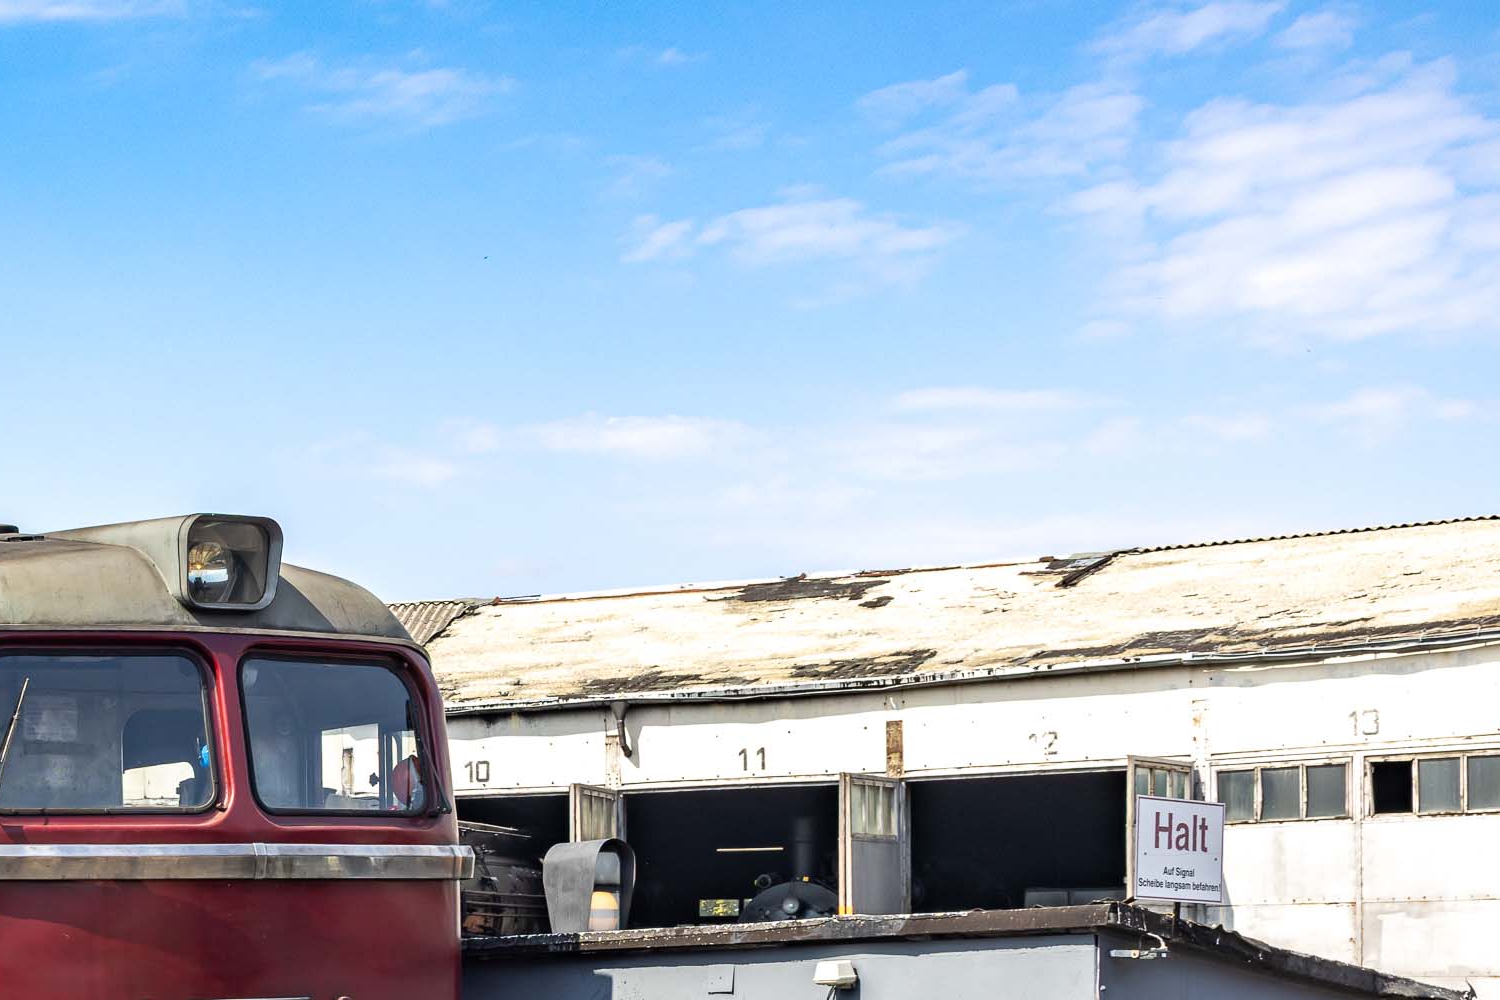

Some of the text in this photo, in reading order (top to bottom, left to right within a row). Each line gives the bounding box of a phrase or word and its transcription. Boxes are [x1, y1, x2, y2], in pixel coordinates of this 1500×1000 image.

[1348, 708, 1379, 736] 13
[738, 747, 767, 771] 11
[464, 760, 490, 783] 10
[1154, 811, 1209, 853] Halt
[1162, 866, 1195, 879] Auf Signal
[1138, 877, 1164, 888] Scheibe
[1164, 880, 1191, 892] langsam
